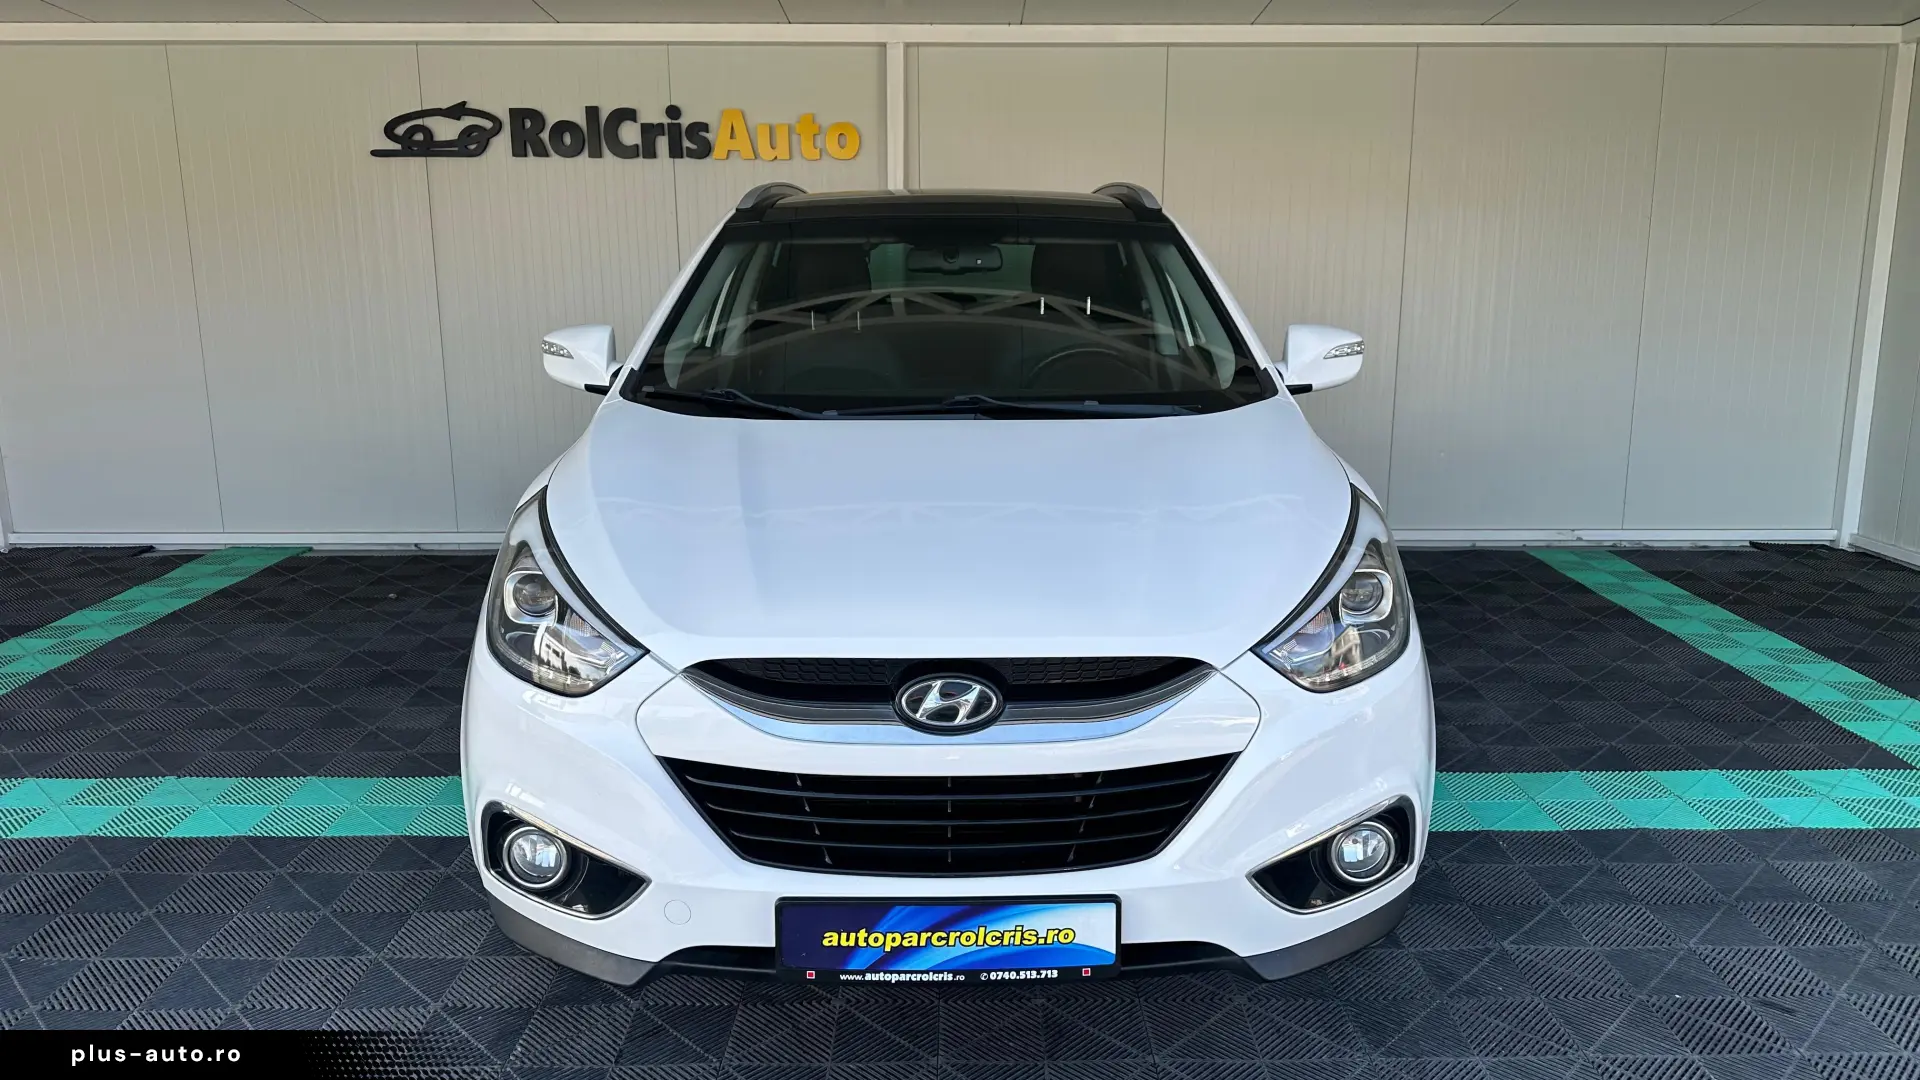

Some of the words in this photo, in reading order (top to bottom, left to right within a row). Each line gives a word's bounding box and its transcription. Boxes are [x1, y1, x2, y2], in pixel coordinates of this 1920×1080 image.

[508, 105, 861, 161] RolCrisAuto
[822, 925, 1076, 951] autoparcrolcris.ro
[839, 970, 965, 983] www.autoparcrolcris.ro
[989, 970, 1058, 981] 0740.513.713
